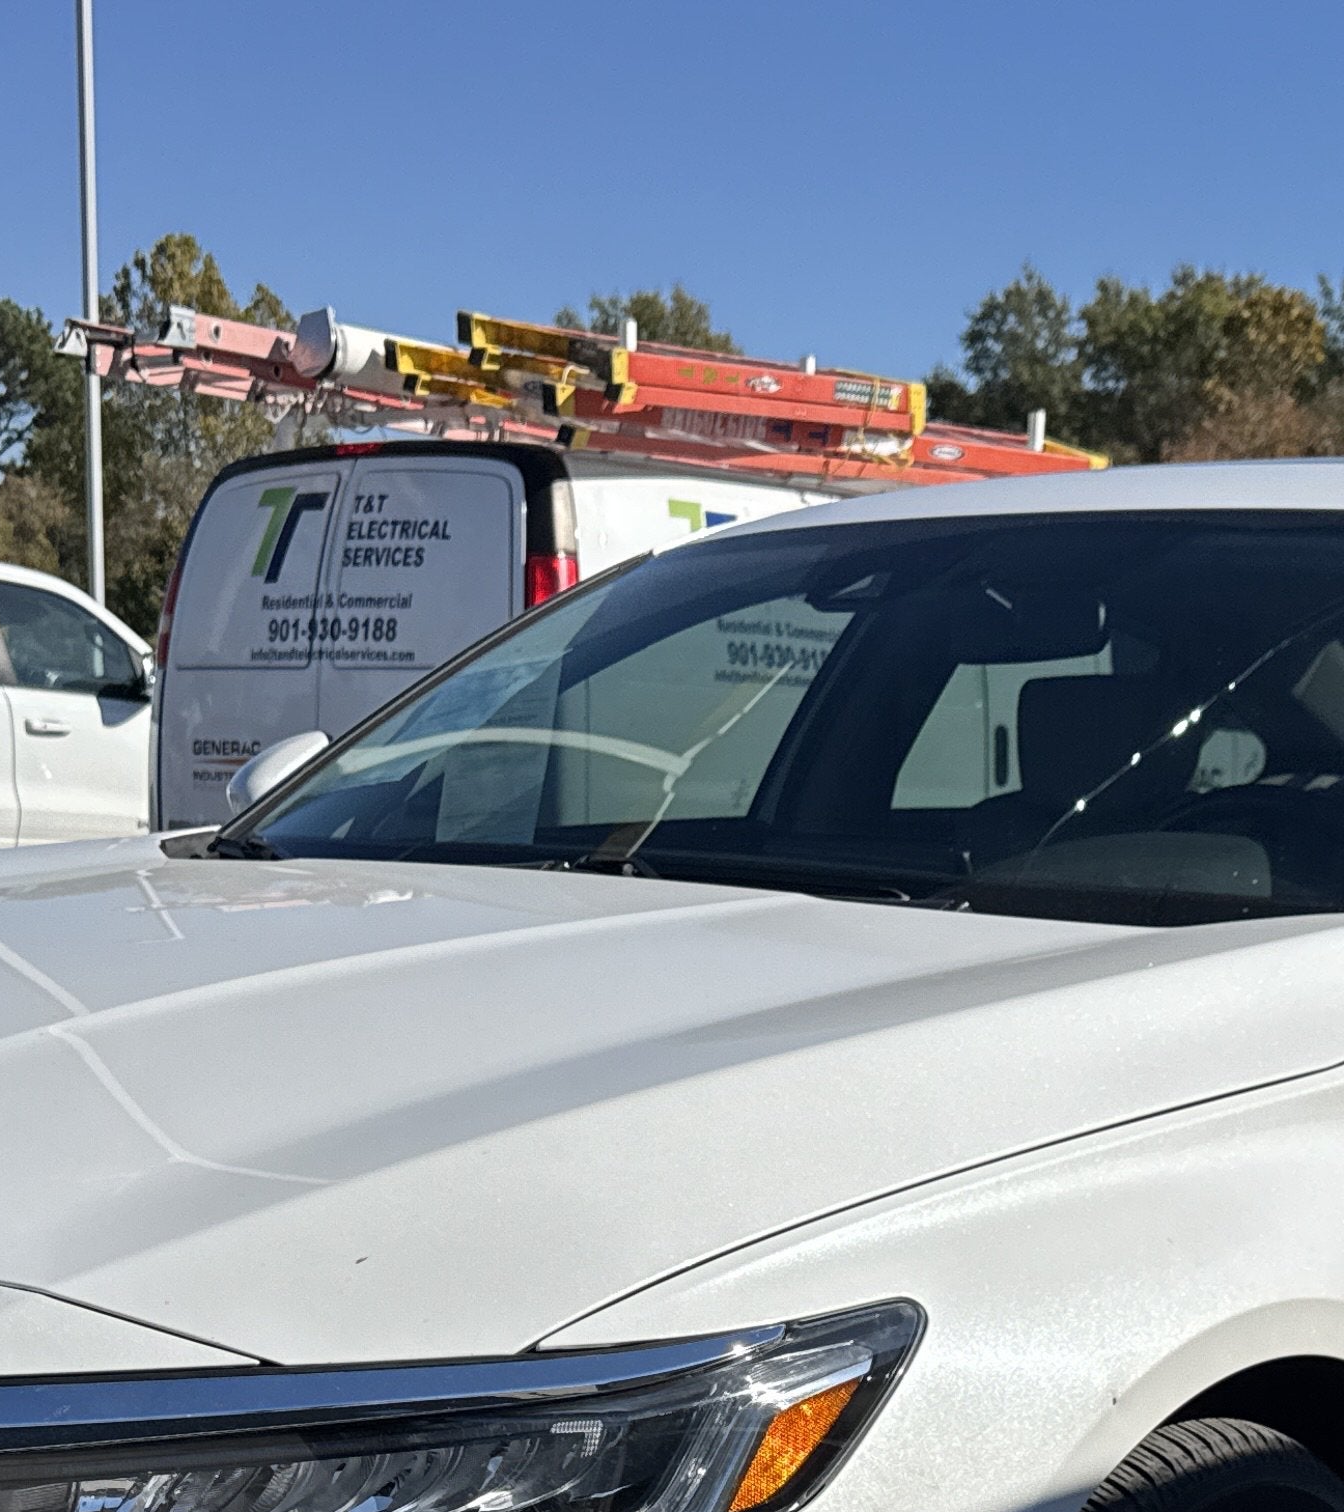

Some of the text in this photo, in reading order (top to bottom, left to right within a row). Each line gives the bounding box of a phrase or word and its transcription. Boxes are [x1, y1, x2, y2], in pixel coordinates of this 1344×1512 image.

[355, 494, 390, 514] T&T
[346, 519, 452, 541] ELECTRICAL
[342, 546, 426, 567] SERVICES
[262, 593, 413, 610] Residential & Commercial
[268, 617, 398, 642] 901-930-9188
[193, 740, 261, 756] GENERAC
